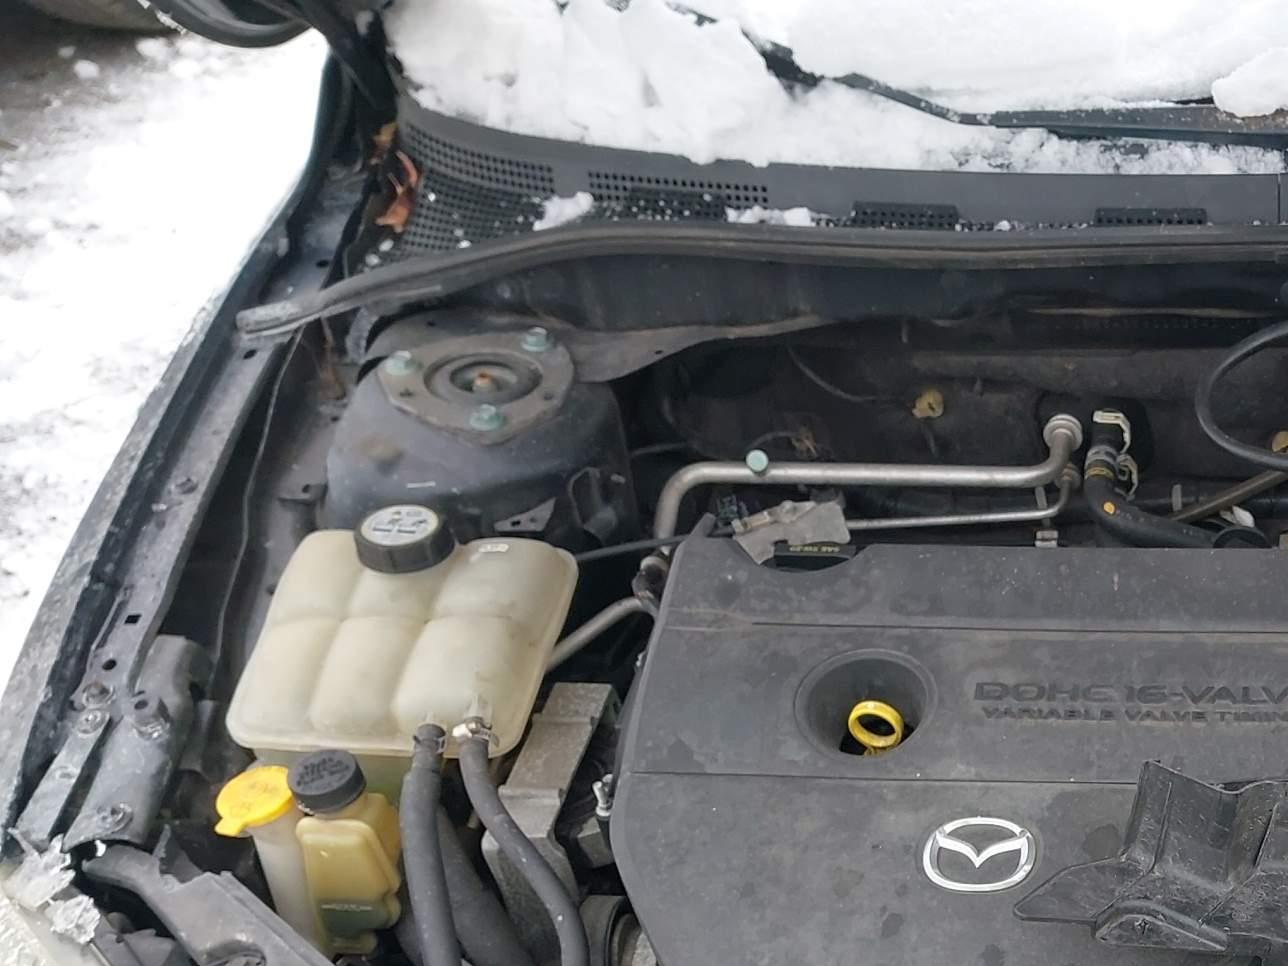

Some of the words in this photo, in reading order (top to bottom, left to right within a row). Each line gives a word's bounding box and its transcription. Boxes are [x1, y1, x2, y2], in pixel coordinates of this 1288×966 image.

[974, 682, 1116, 703] DOHC
[981, 706, 1115, 722] VARIABLE
[1124, 708, 1209, 723] VALVE
